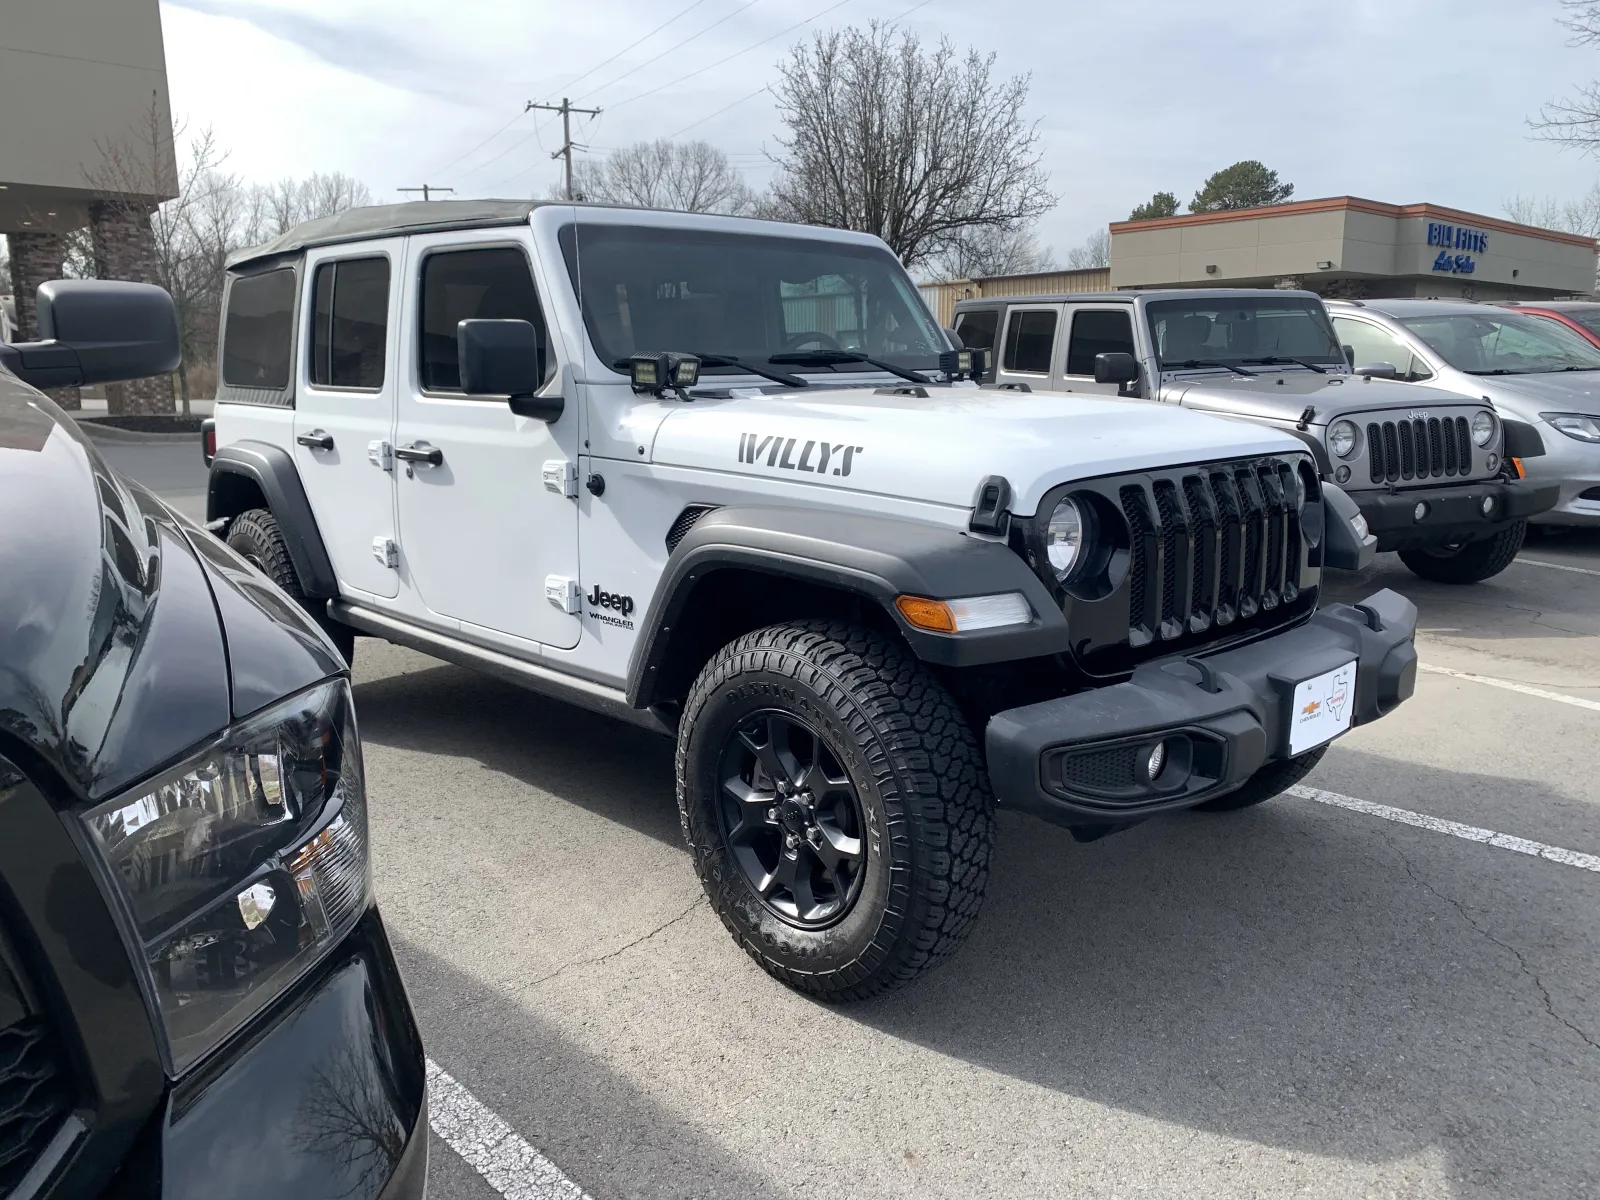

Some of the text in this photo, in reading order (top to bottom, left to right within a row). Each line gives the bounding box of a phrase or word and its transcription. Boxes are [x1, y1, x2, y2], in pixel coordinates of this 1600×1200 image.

[1428, 223, 1489, 253] BILL FITTS
[1408, 410, 1429, 419] Jeep
[738, 433, 864, 477] WILLYS
[587, 583, 634, 617] Jeep
[589, 612, 633, 627] WRANGLER
[725, 681, 860, 771] DESTINATION
[1299, 712, 1321, 723] CHEVROLET
